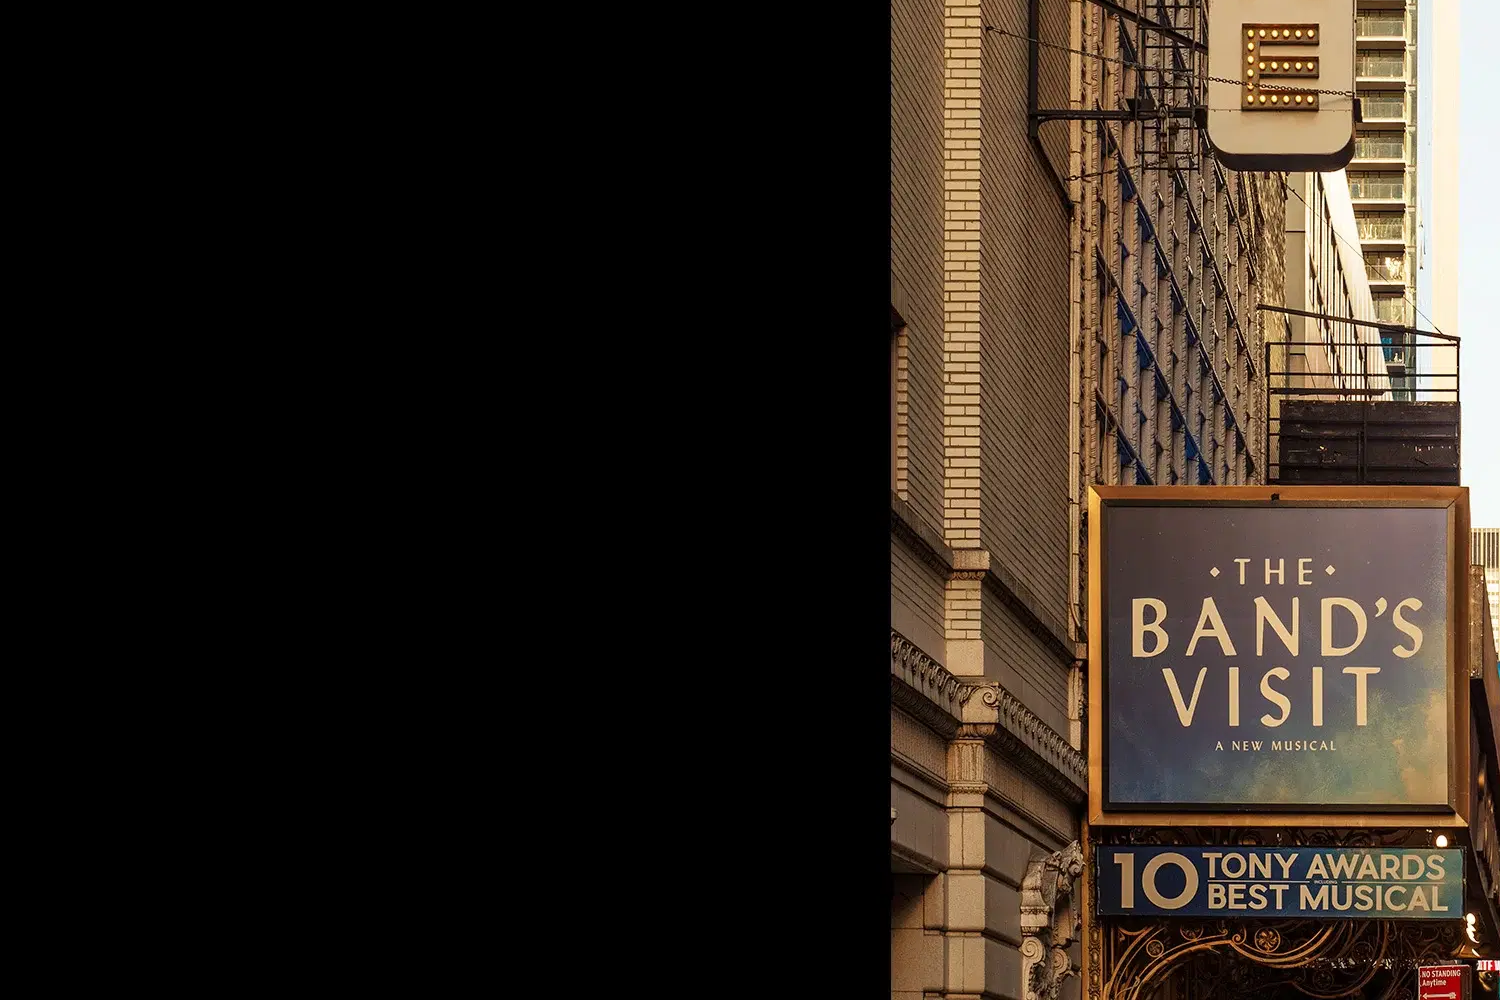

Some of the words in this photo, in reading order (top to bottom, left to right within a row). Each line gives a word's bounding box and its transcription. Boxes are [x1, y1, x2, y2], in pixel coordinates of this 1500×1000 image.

[1234, 558, 1312, 585] THE
[1132, 596, 1423, 658] BAND'S
[1162, 666, 1381, 727] VISIT
[1215, 740, 1224, 751] A
[1232, 740, 1263, 751] NEW
[1271, 740, 1336, 751] MUSICAL
[1202, 852, 1299, 879] TONY
[1306, 853, 1445, 880] AWARDS
[1114, 852, 1199, 910] 10
[1208, 884, 1289, 910] BEST
[1300, 884, 1449, 911] MUSICAL
[1421, 970, 1431, 978] NO
[1432, 969, 1461, 977] STANDING
[1422, 979, 1447, 988] Anytime
